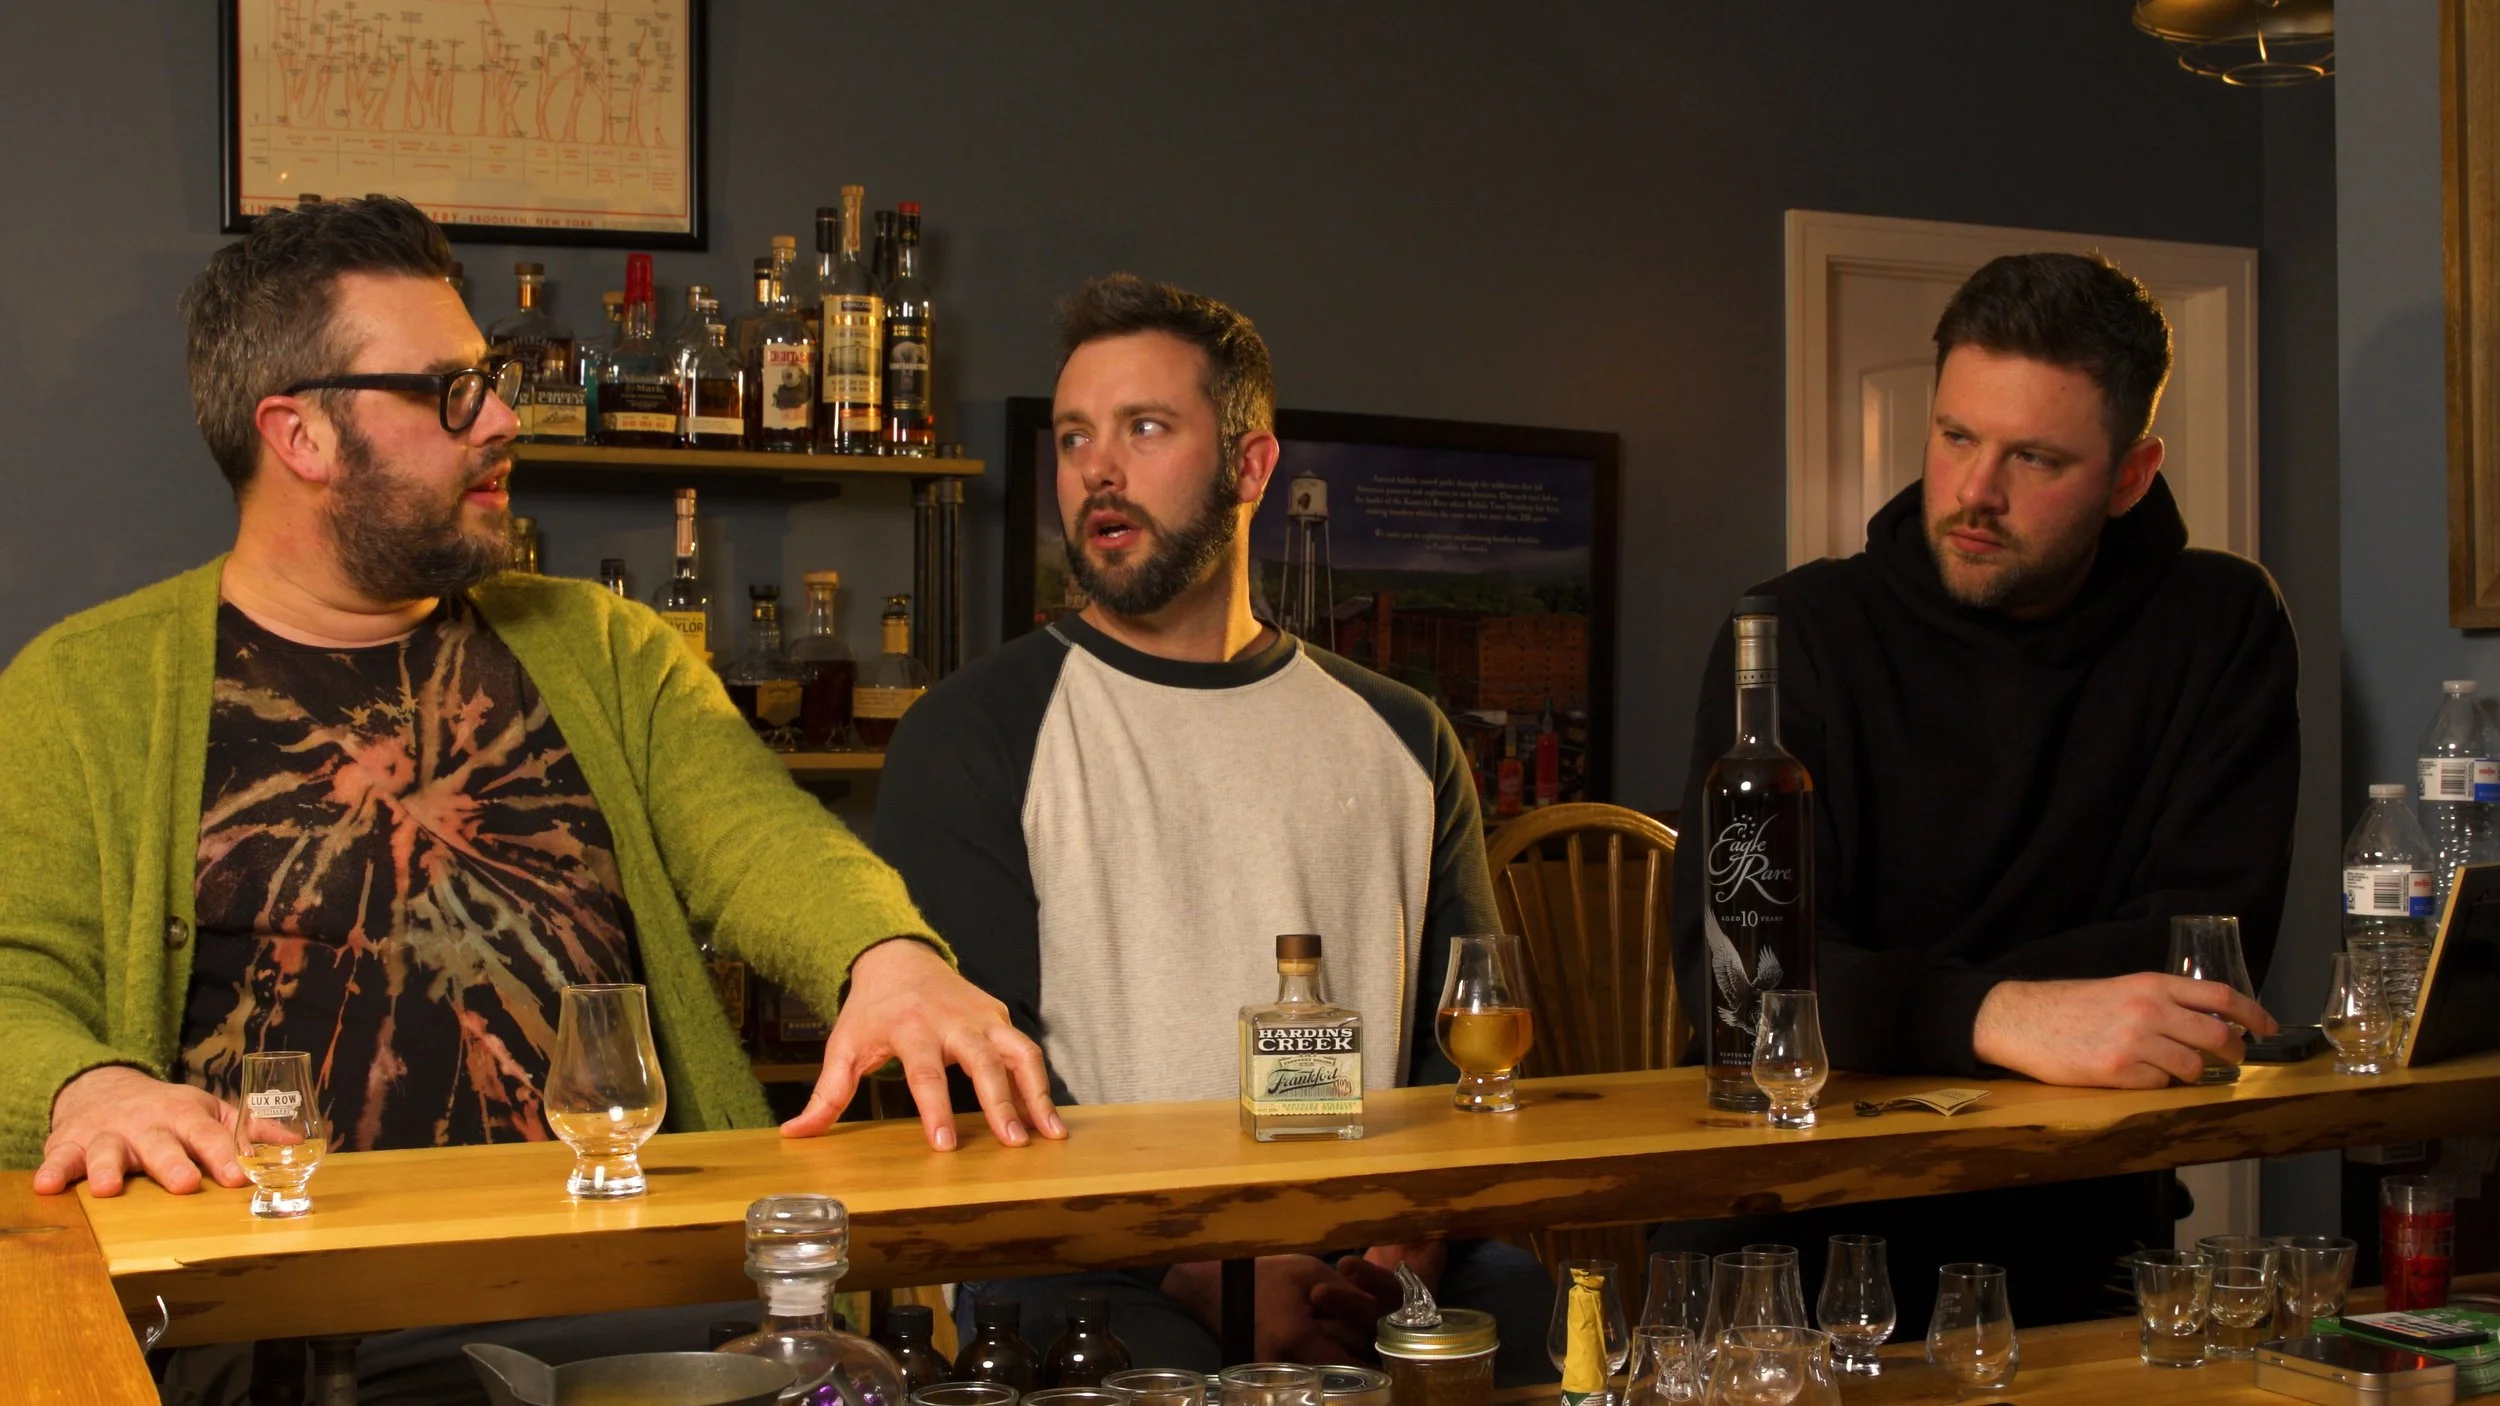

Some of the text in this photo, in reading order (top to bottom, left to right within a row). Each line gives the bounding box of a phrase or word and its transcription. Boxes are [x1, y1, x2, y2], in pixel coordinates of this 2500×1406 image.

[536, 217, 560, 226] NEW
[565, 218, 593, 227] YORK
[1708, 813, 1779, 886] Eagle
[1715, 853, 1800, 905] Rare
[1721, 910, 1784, 927] AGED 10 YEARS
[1258, 1028, 1354, 1039] HARDINS
[1258, 1037, 1353, 1051] CREEK
[1267, 1066, 1339, 1095] Frankfort
[251, 1094, 297, 1106] LUX ROW
